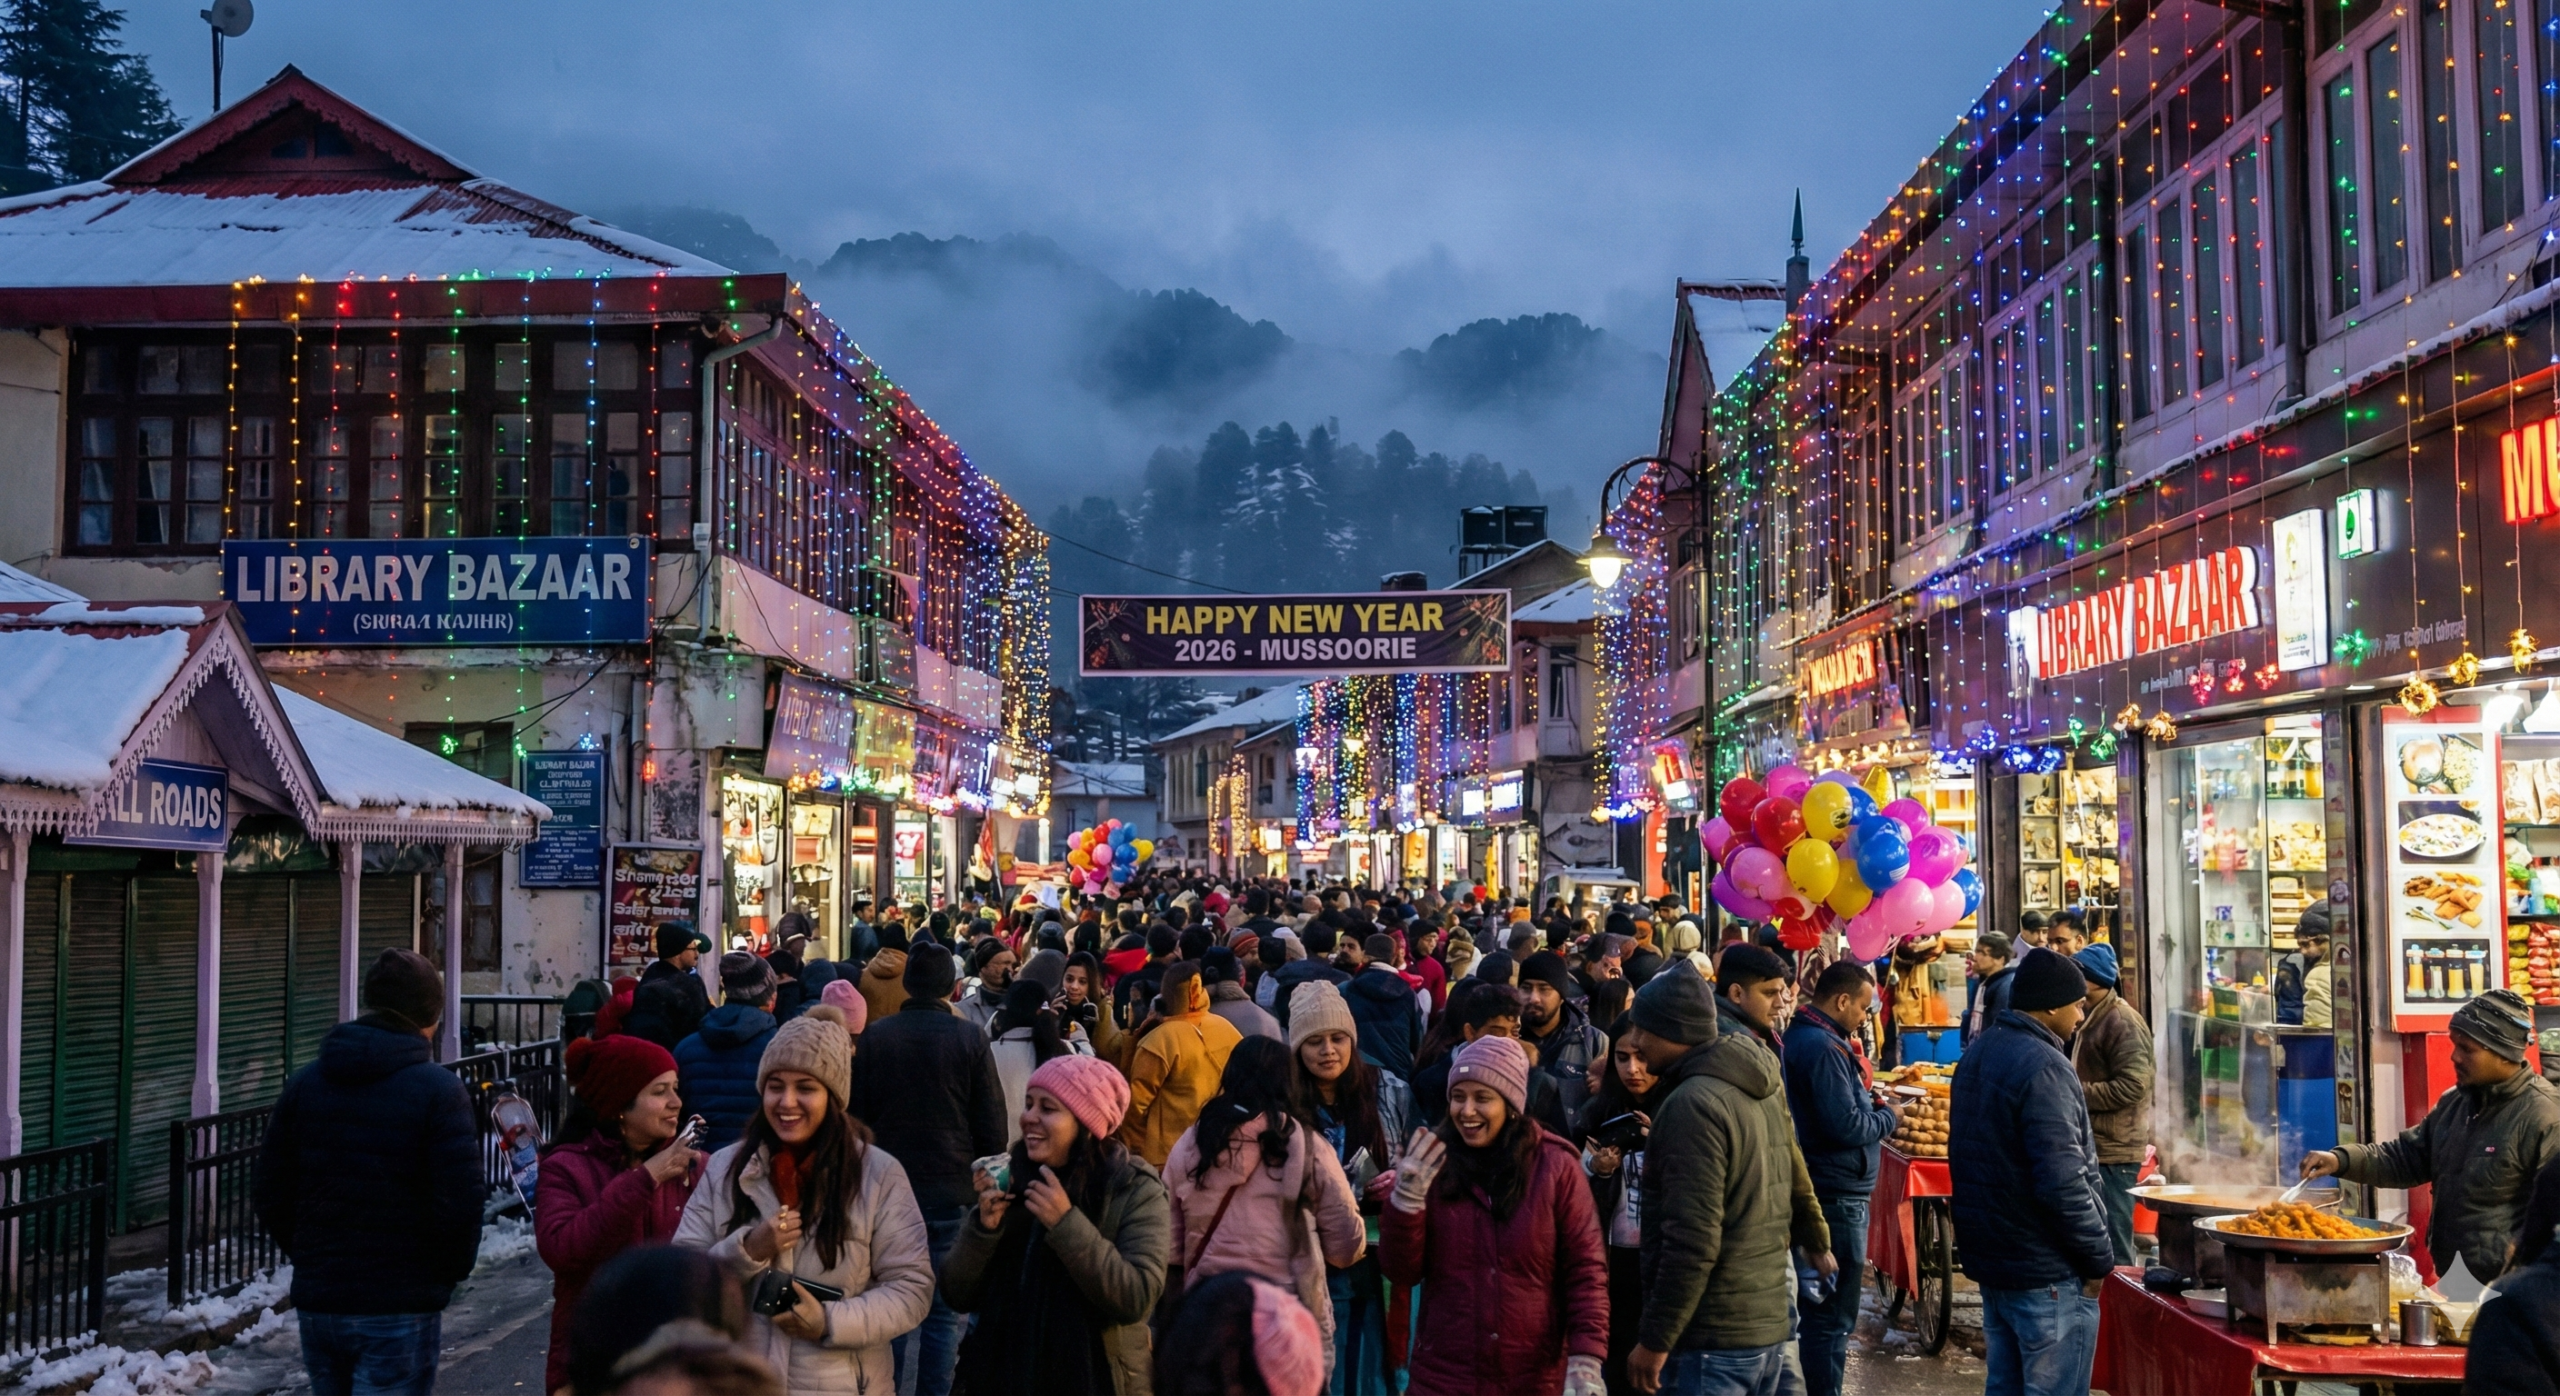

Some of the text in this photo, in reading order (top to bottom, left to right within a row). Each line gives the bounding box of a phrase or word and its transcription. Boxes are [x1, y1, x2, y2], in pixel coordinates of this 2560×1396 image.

[237, 553, 632, 602] LIBRARY BAZAAR
[1146, 602, 1444, 634] HAPPY NEW YEAR
[2037, 546, 2248, 680] LIBRARY BAZAAR
[1174, 639, 1236, 661] 2026
[1260, 637, 1416, 661] MUSSOORIE
[150, 781, 222, 829] ROADS
